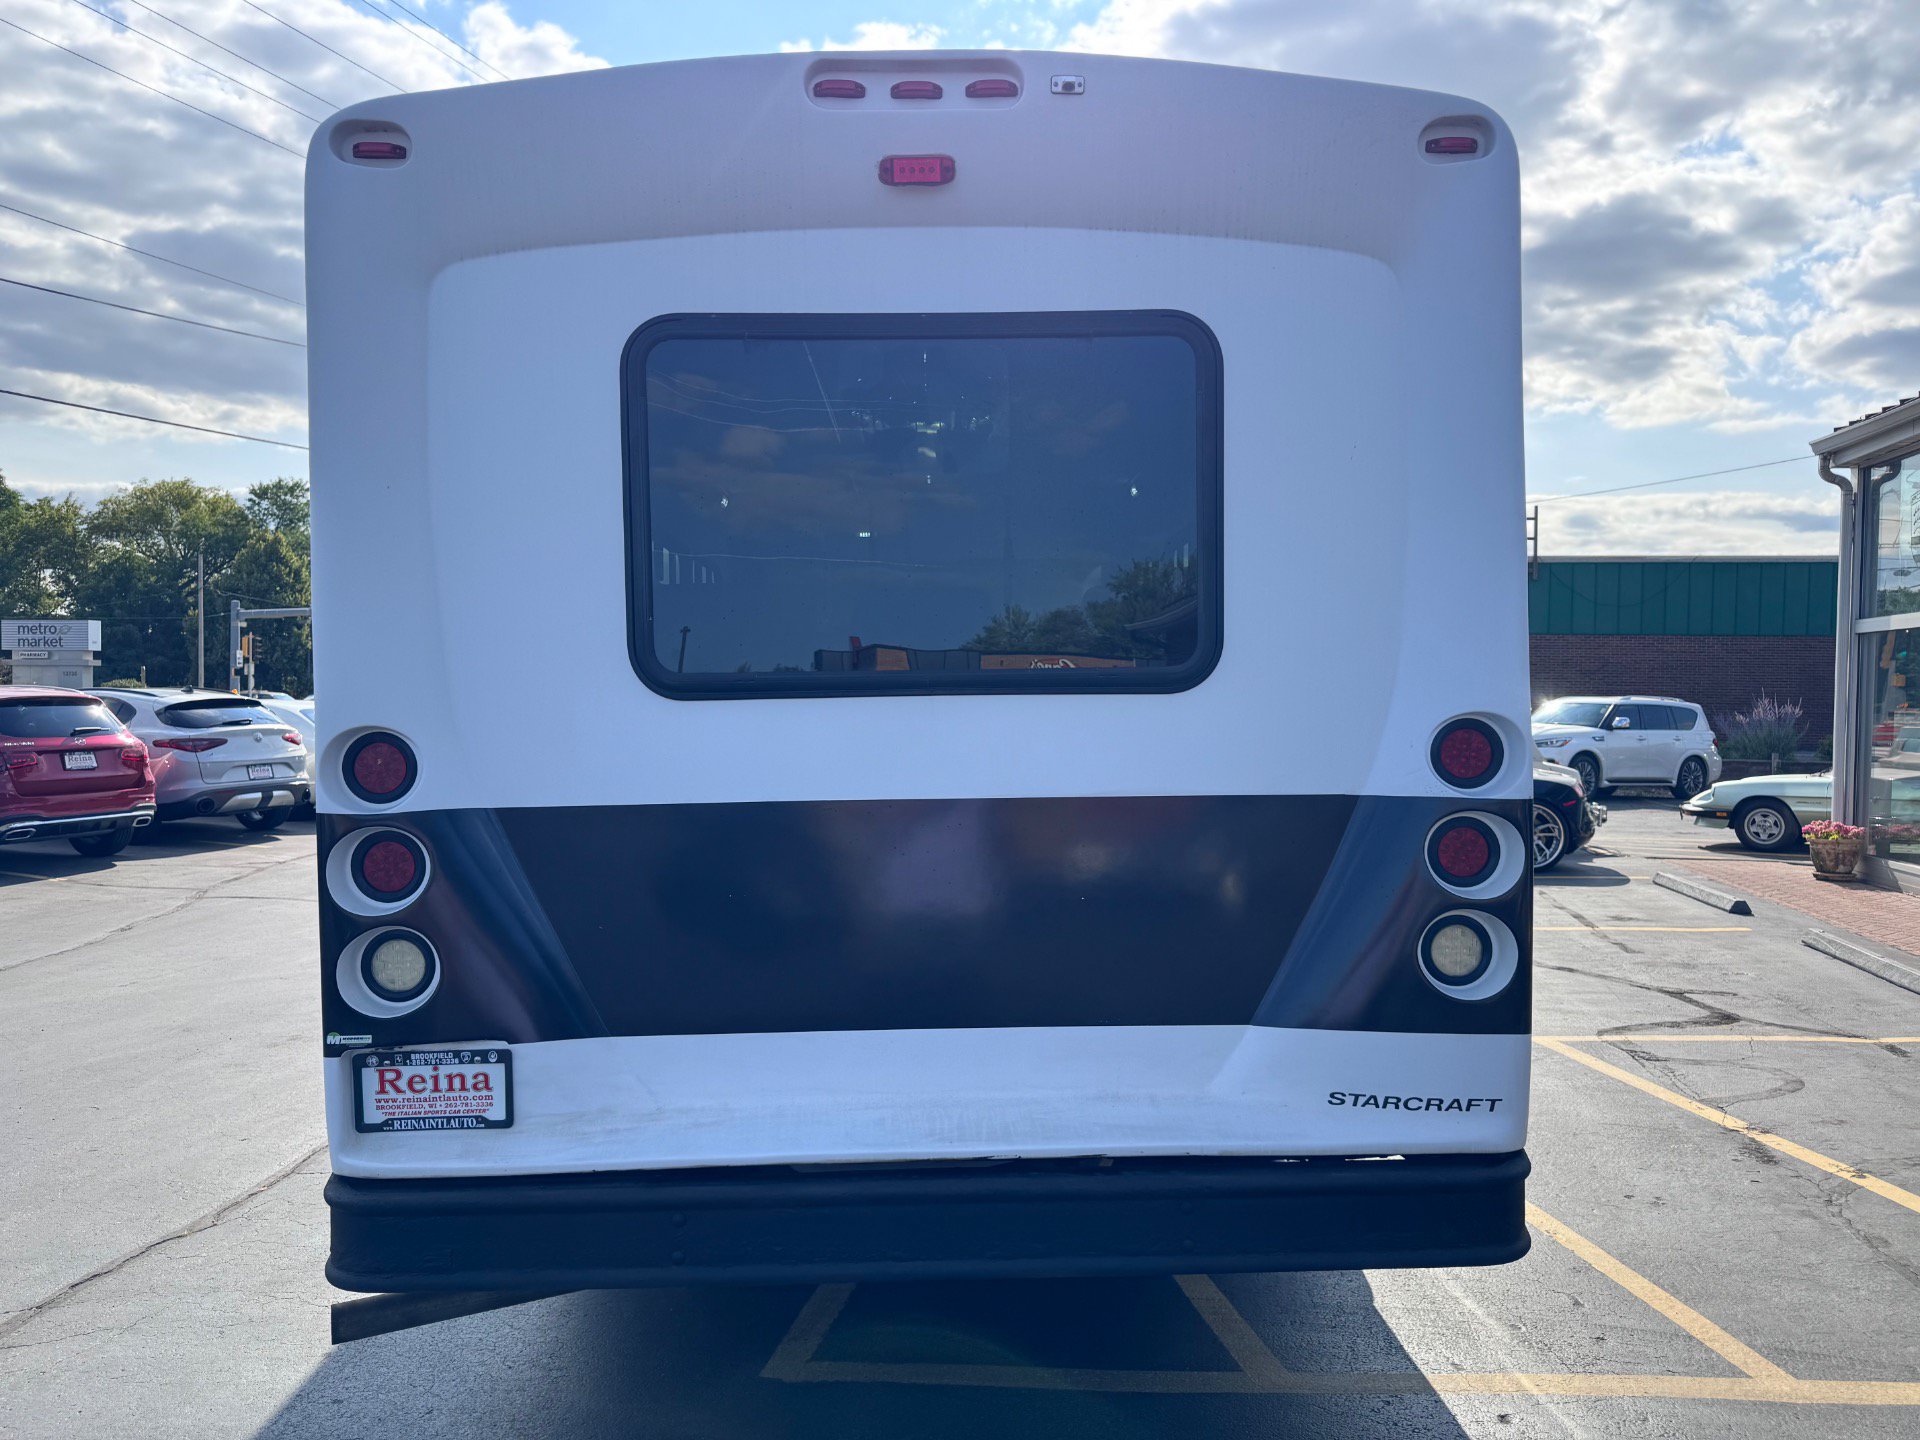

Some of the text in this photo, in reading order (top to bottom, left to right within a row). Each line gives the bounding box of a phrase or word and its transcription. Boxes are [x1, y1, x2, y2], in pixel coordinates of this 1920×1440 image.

[17, 622, 57, 635] metro
[17, 635, 64, 648] market
[67, 754, 93, 763] Reina
[410, 1052, 453, 1060] BROOKFIELD
[405, 1058, 459, 1066] 1-262-781-3336
[374, 1065, 493, 1095] Reina
[374, 1094, 494, 1104] www.reinaintlauto.com
[1327, 1091, 1503, 1112] STARCRAFT
[375, 1103, 426, 1111] BROOKFIELD,
